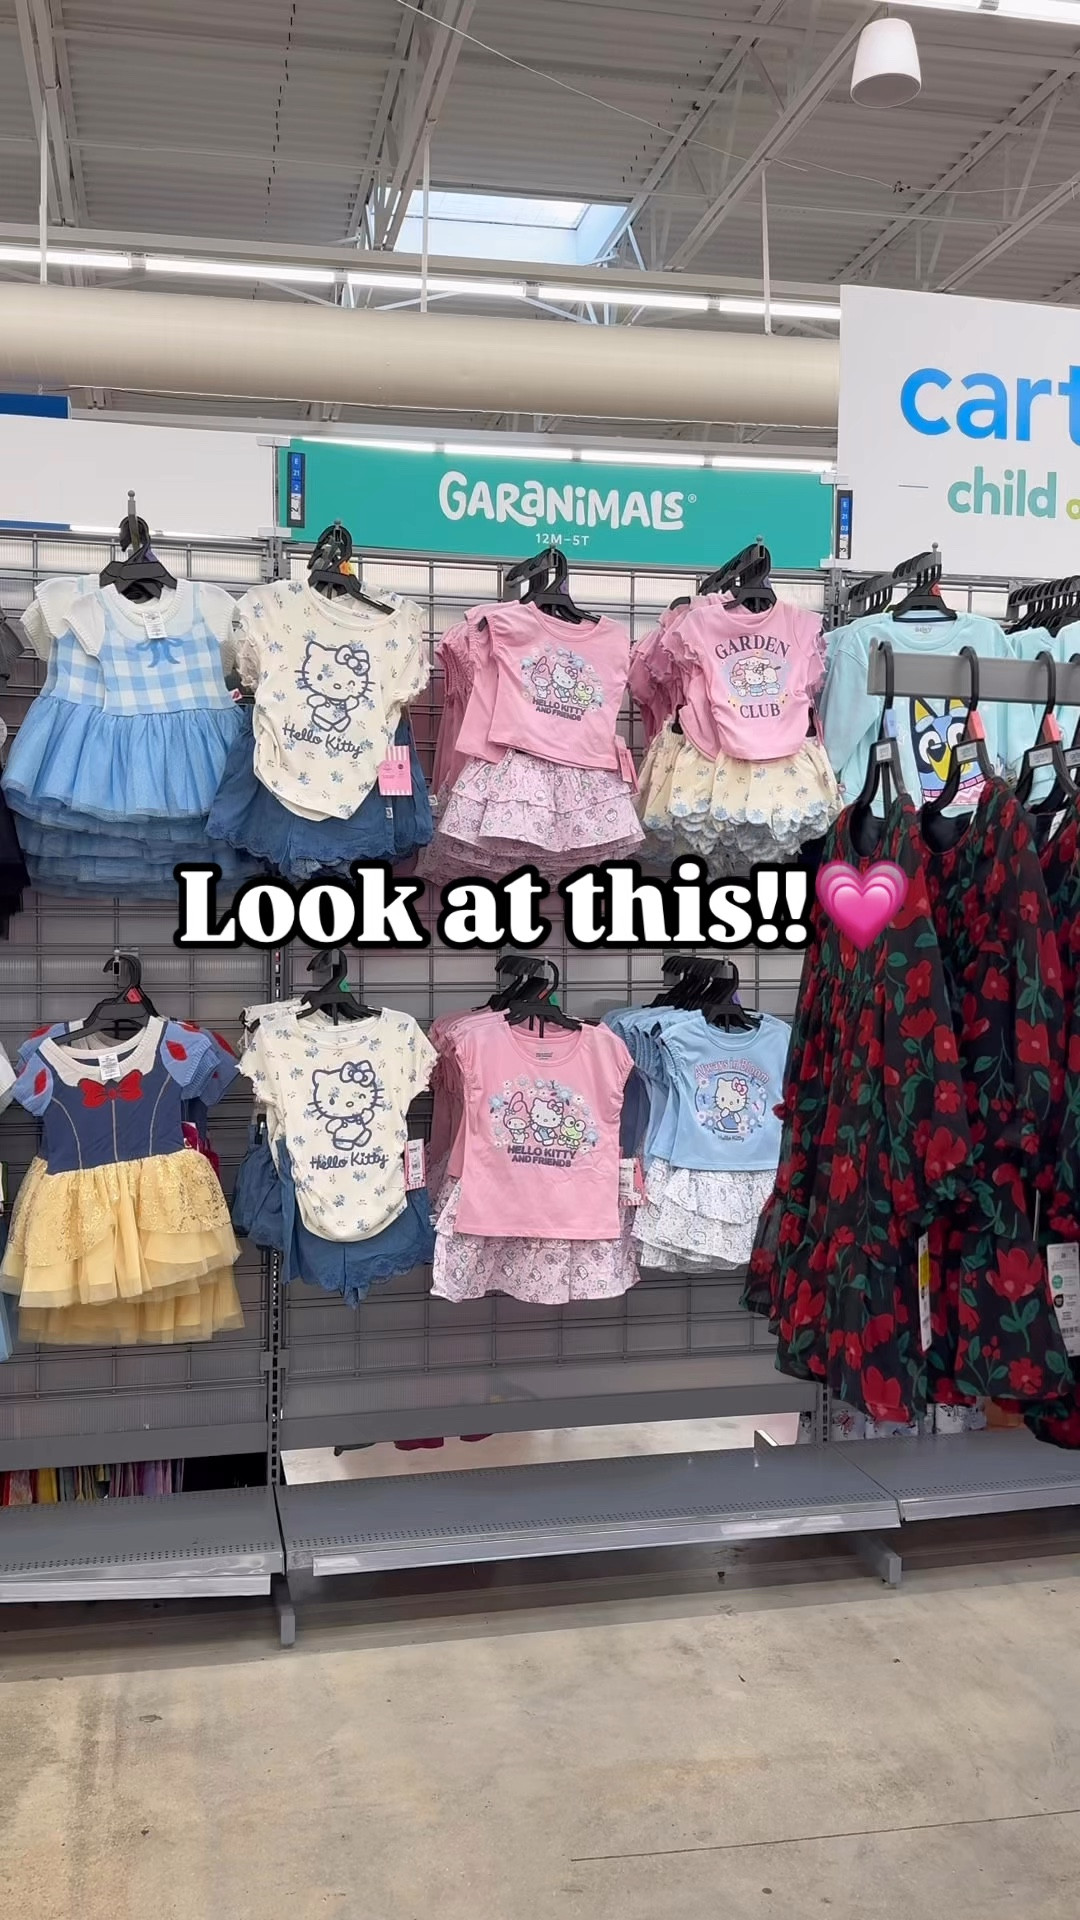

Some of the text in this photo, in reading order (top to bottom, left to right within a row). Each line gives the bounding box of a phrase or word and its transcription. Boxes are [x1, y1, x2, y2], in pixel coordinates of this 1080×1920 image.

[947, 466, 1057, 519] child
[715, 634, 790, 660] GARDEN
[532, 697, 587, 716] HELLO KITTY
[535, 705, 582, 722] AND FRIENDS
[739, 703, 781, 719] CLUB
[282, 722, 364, 759] Hello Kitty
[310, 1155, 349, 1170] Hello
[350, 1151, 389, 1169] Kitty
[507, 1145, 577, 1159] HELLO KITTY
[511, 1154, 572, 1168] AND FRIENDS
